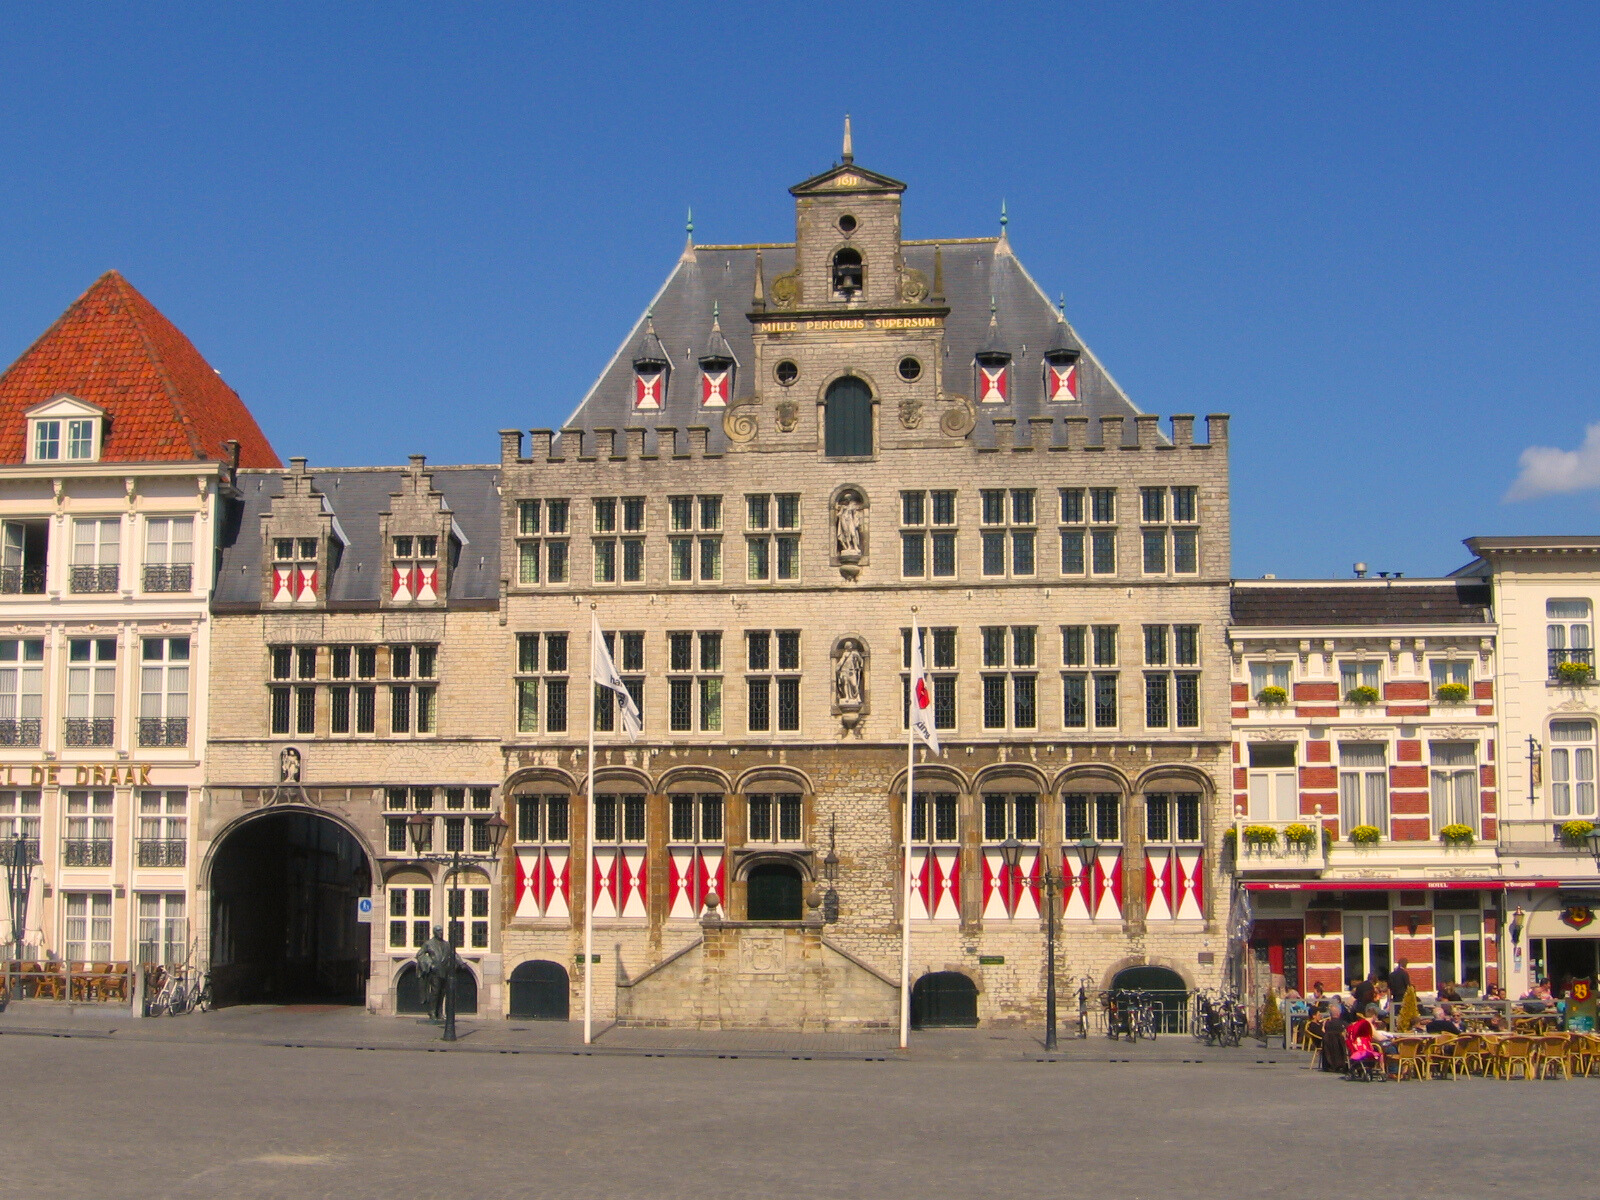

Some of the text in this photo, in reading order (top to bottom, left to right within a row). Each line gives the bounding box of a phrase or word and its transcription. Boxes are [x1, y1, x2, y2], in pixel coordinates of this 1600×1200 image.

[836, 176, 857, 187] 1611
[761, 317, 936, 332] MILLE PERICULIS SUPERSUM
[32, 764, 61, 786] DE
[76, 763, 152, 786] DRAAK
